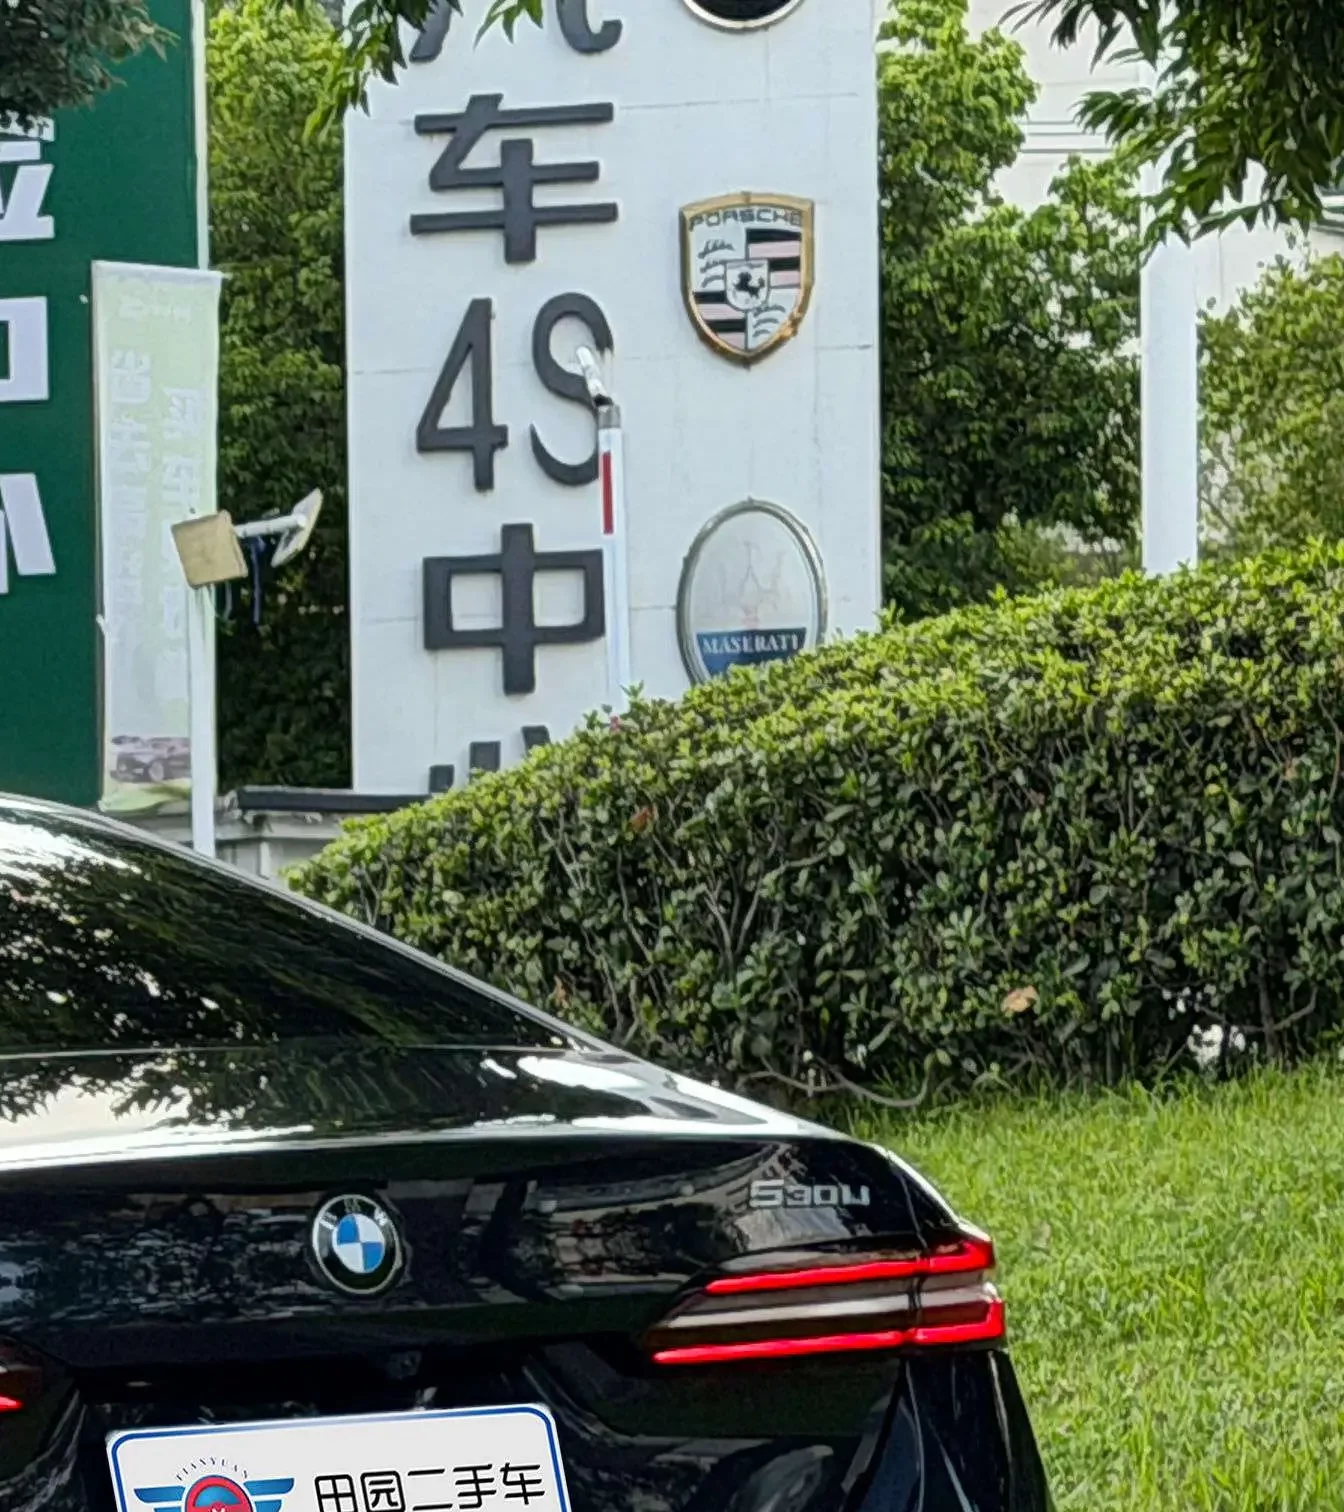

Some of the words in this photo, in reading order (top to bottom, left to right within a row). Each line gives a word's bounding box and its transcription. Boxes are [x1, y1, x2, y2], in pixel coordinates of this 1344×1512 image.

[689, 208, 802, 232] PORSCHE
[409, 0, 623, 795] 车4S中
[702, 634, 799, 654] MASERATI
